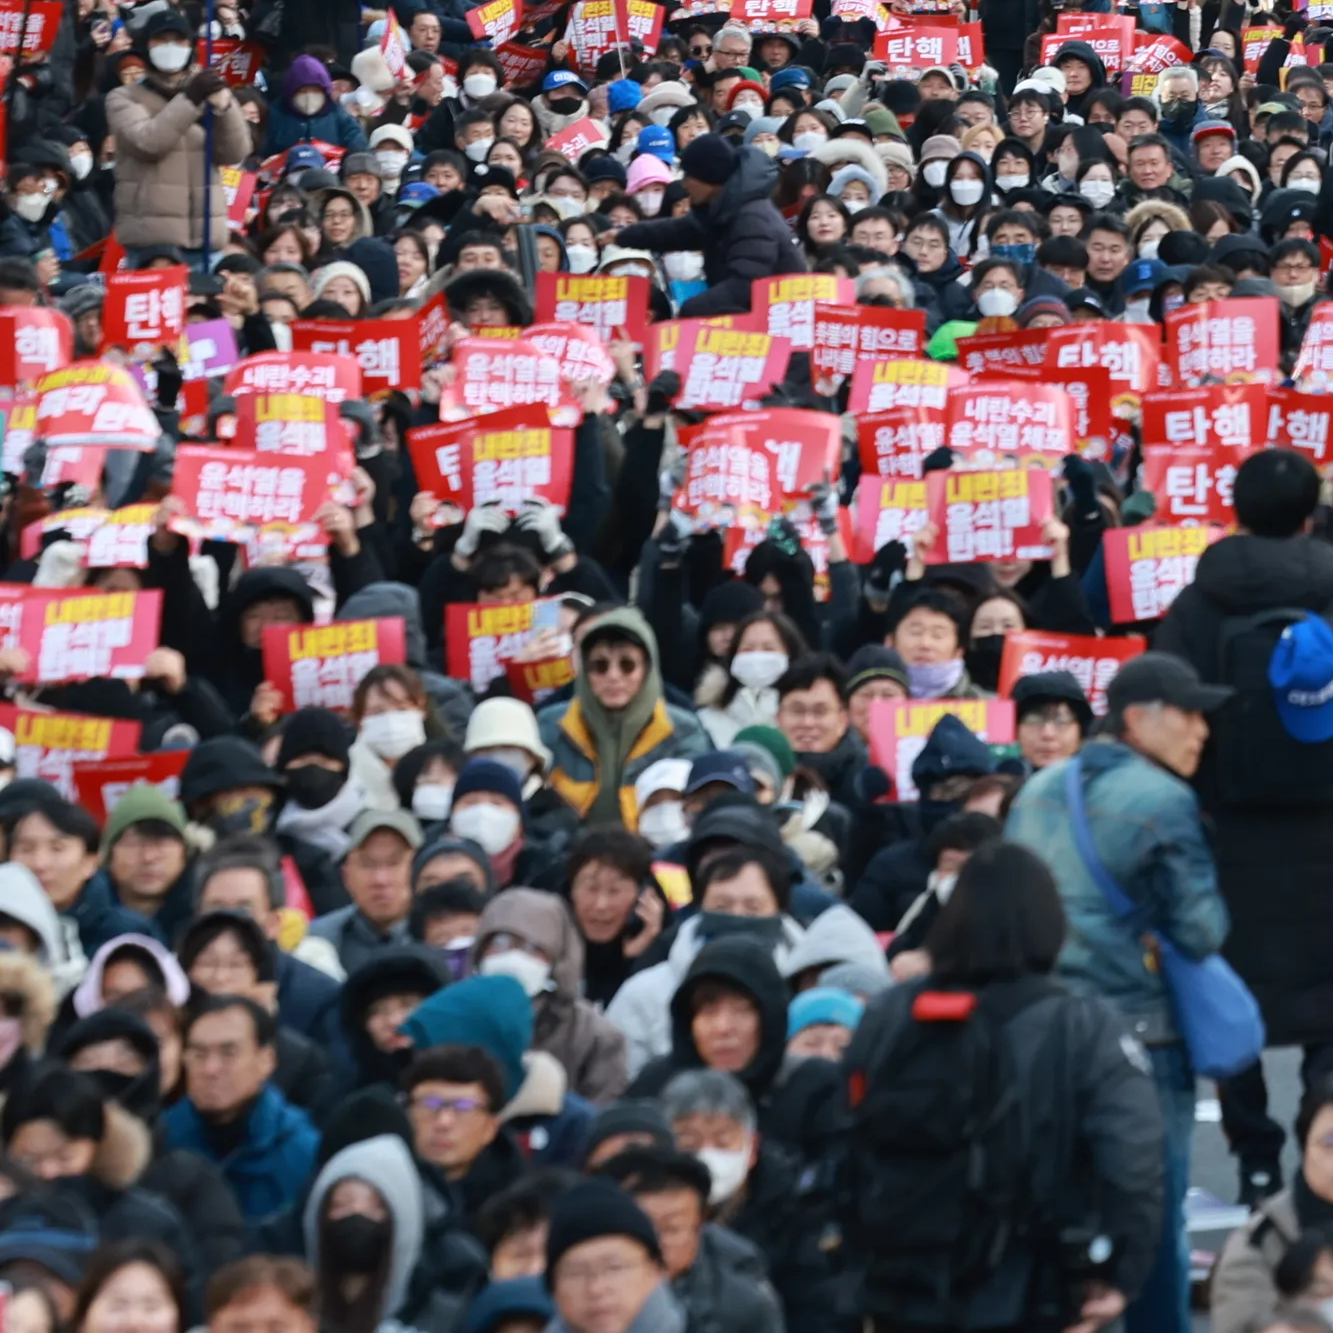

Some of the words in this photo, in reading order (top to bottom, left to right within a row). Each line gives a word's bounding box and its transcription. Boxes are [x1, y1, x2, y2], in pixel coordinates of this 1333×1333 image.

[888, 36, 943, 64] 탄핵
[965, 397, 1056, 426] 내란수괴
[1165, 402, 1251, 446] 탄핵
